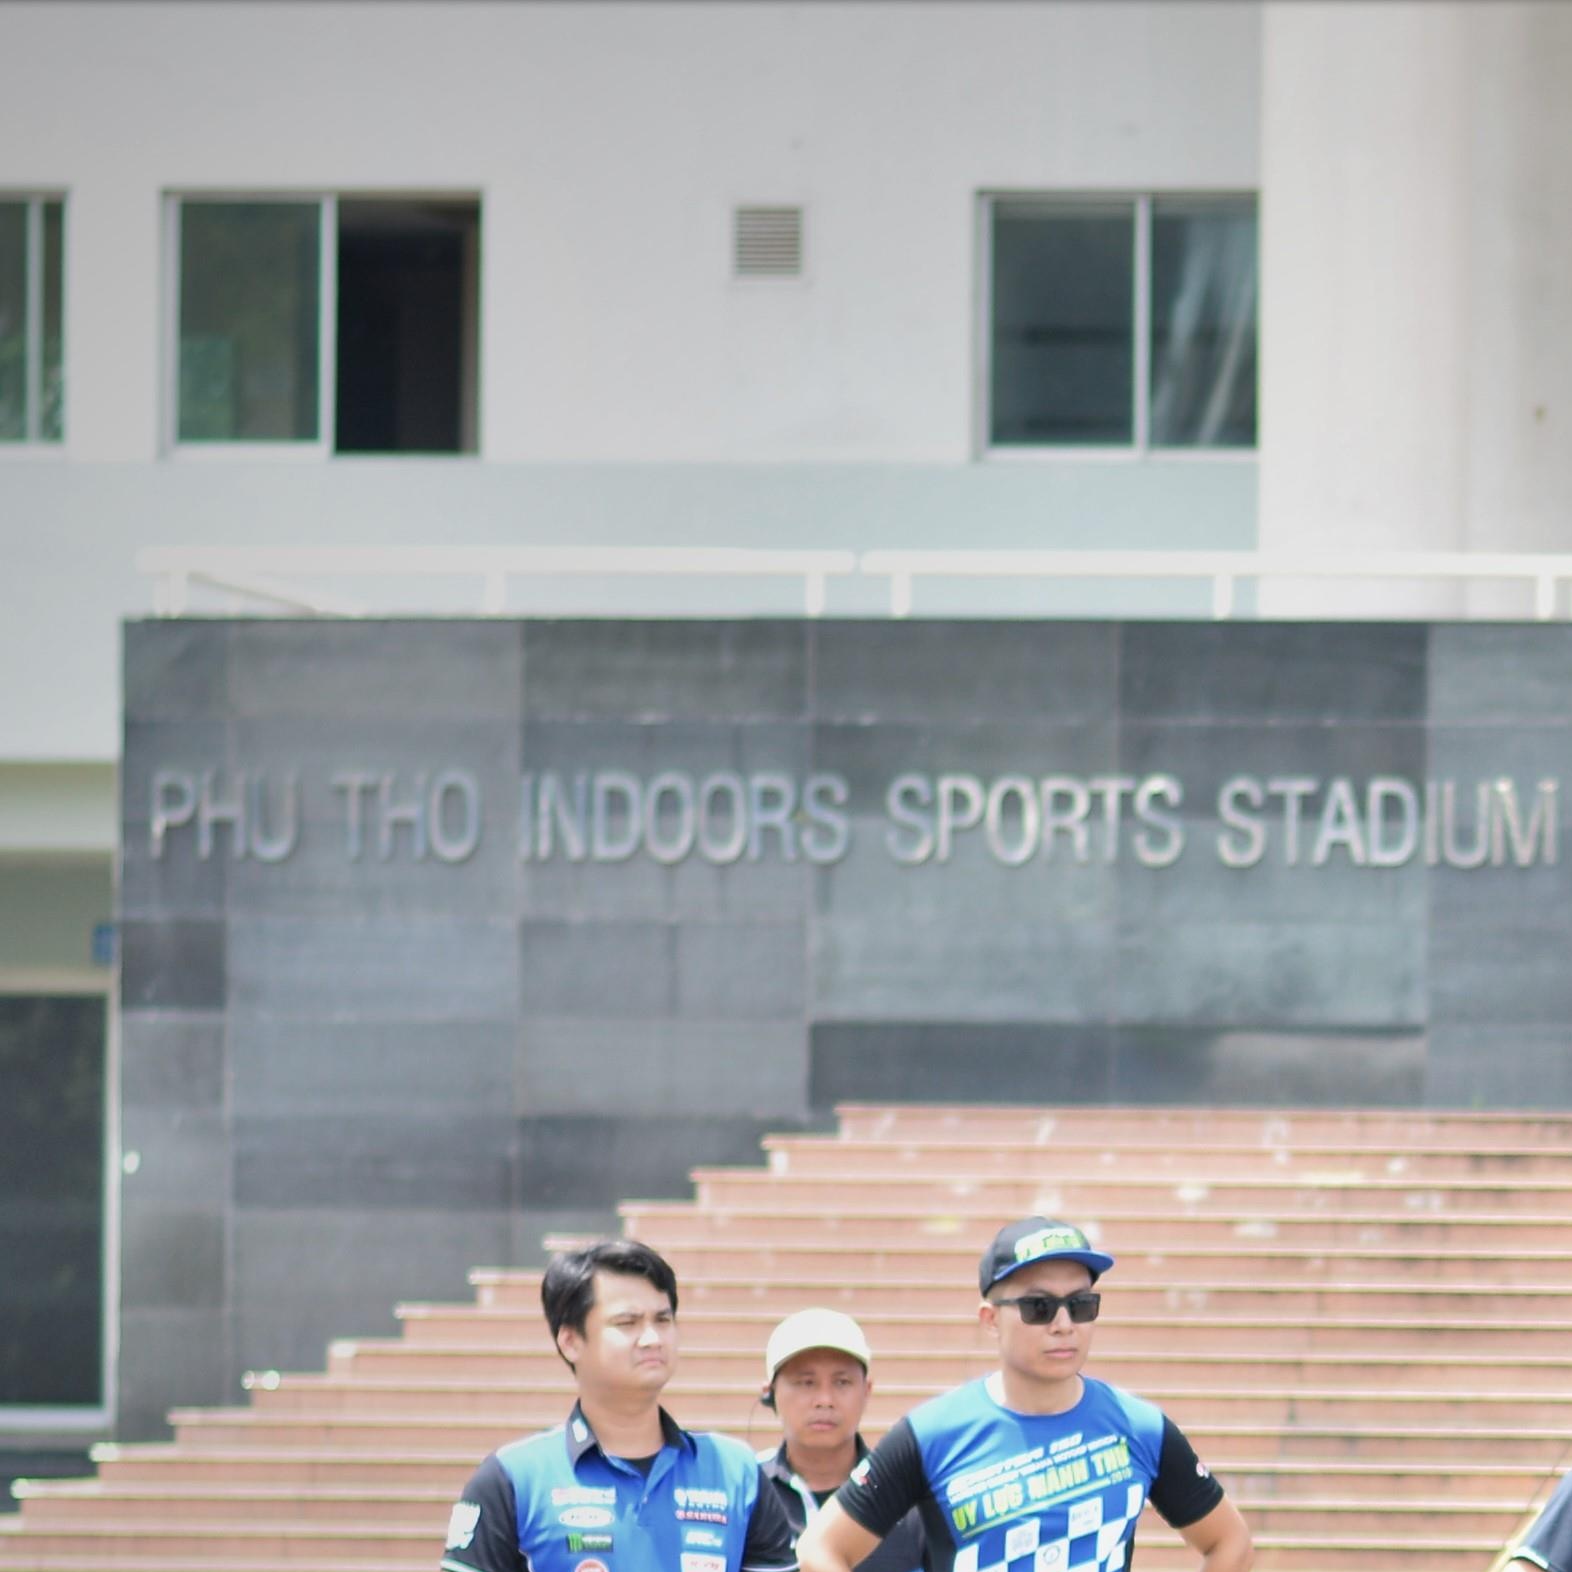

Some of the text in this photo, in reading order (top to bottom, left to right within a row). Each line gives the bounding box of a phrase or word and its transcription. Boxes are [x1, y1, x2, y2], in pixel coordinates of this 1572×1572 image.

[150, 769, 1560, 868] PHU THO INDOORS SPORTS STADIUM
